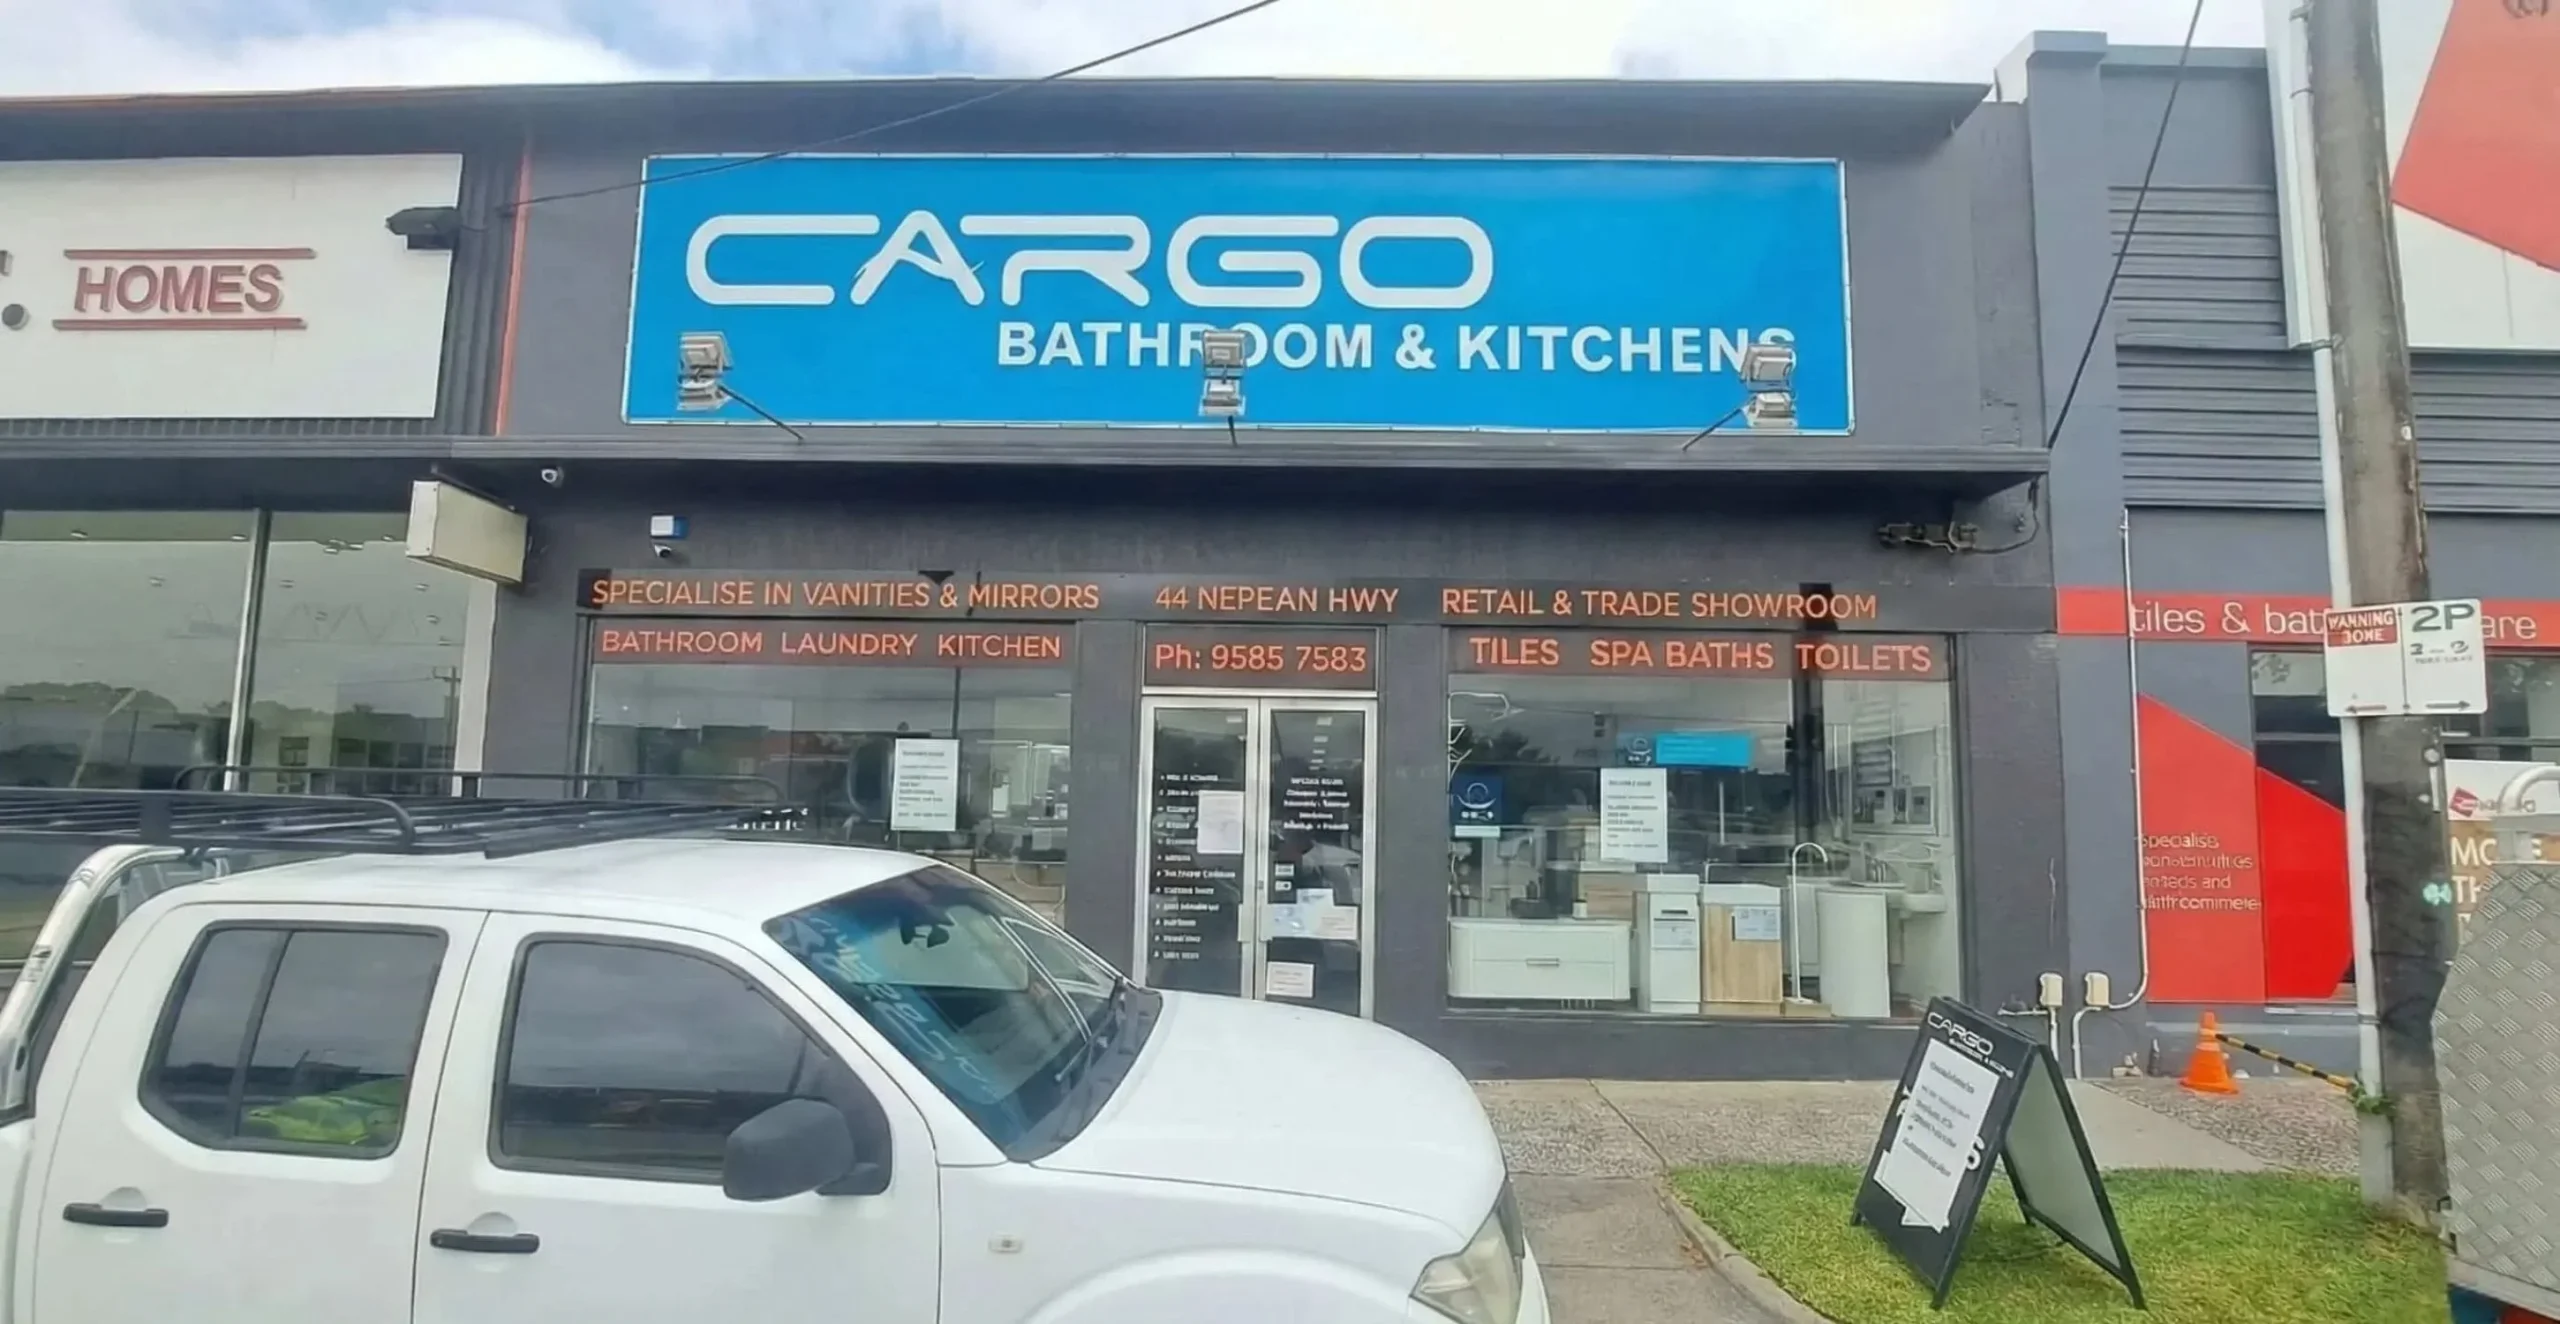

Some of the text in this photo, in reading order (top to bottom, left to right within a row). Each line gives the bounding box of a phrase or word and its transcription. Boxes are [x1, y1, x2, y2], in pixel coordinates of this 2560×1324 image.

[686, 210, 1494, 308] CARGO
[74, 264, 284, 313] HOMES
[1395, 323, 1437, 369] &
[592, 579, 1099, 609] SPECIALISE IN VANITIES & MIRRORS
[1155, 586, 1400, 613] 44 NEPEAN HWY
[1442, 588, 1877, 619] RETAIL & TRADE SHOWROOM
[2131, 600, 2205, 635] tiles
[2221, 602, 2250, 634] &
[2410, 604, 2475, 633] 2P
[602, 630, 1061, 658] BATHROOM LAUNDRY KITCHEN
[1155, 644, 1367, 672] Ph: 9585 7583
[1469, 637, 1932, 672] TILES SPA BATHS TOILETS
[1927, 1011, 1994, 1056] CARGO
